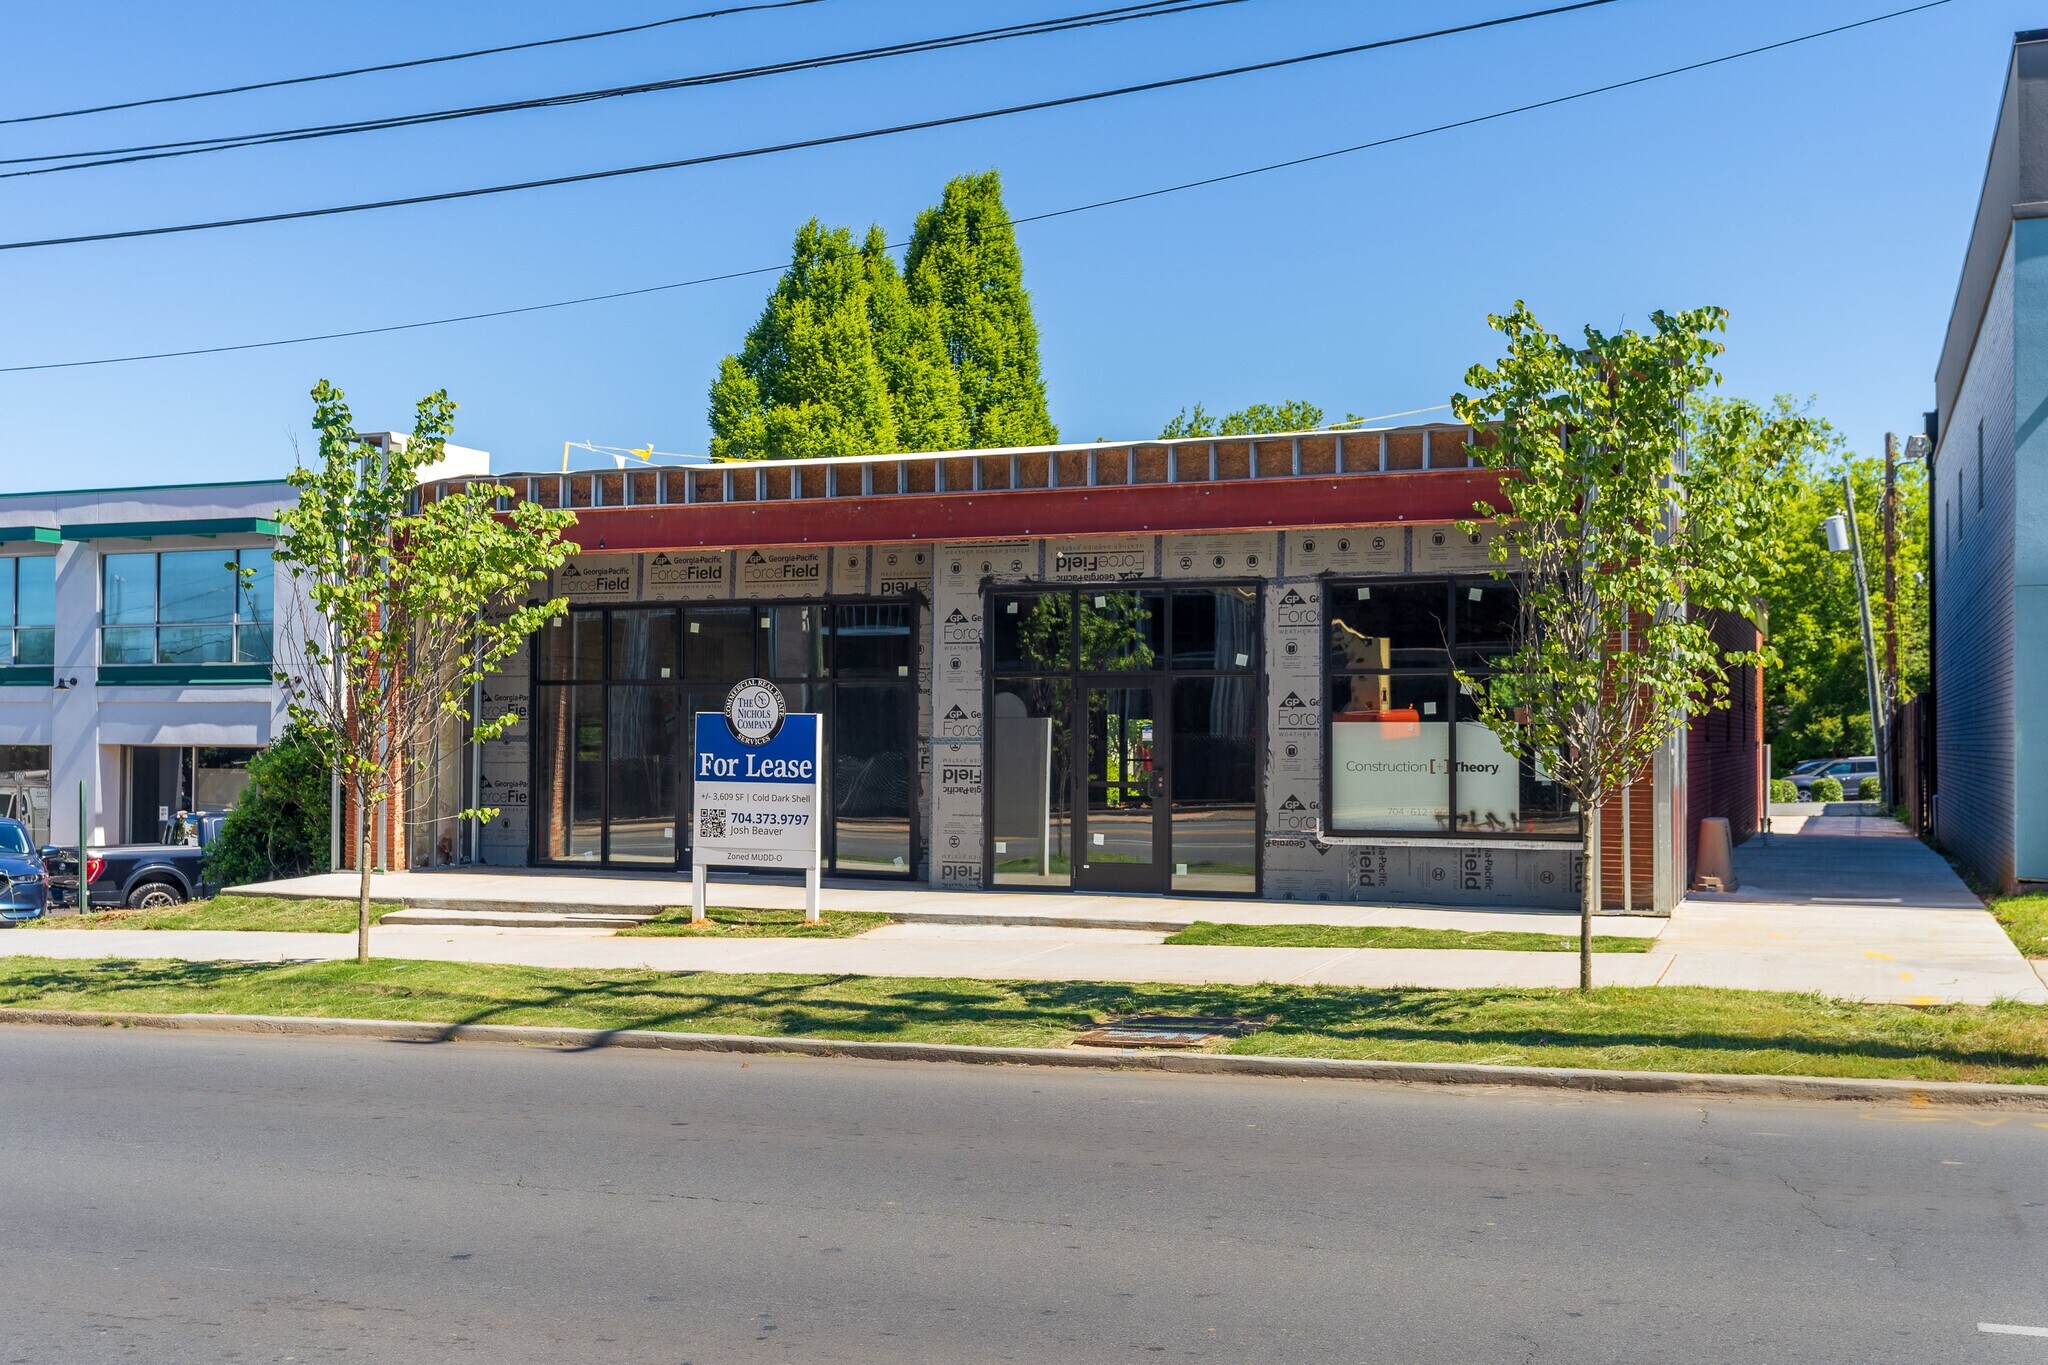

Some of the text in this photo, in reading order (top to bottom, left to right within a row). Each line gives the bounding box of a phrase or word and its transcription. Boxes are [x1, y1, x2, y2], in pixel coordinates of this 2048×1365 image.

[673, 556, 722, 566] Georgia-Pacific
[768, 553, 819, 563] Georgia-Pacific
[1056, 555, 1144, 572] ForceField
[583, 566, 629, 576] Georgia-Pacific
[650, 566, 722, 580] ForceField
[744, 564, 819, 579] ForceField
[561, 577, 630, 591] ForceField
[726, 679, 785, 719] COMMERCIAL REAL ESTATE
[738, 698, 753, 707] THE
[738, 709, 771, 718] NICHOLS
[738, 719, 773, 729] COMPANY
[737, 733, 771, 745] SERVICES
[700, 753, 812, 779] For Lease
[1346, 760, 1427, 773] Construction
[1455, 761, 1499, 775] Theory
[713, 793, 733, 801] 3,609
[736, 793, 744, 801] SF
[752, 794, 770, 802] Cold
[772, 794, 790, 802] Dark
[792, 795, 811, 803] Shell
[731, 812, 809, 826] 704.373.9797
[730, 826, 783, 836] Josh Beaver
[727, 853, 749, 861] Zoned
